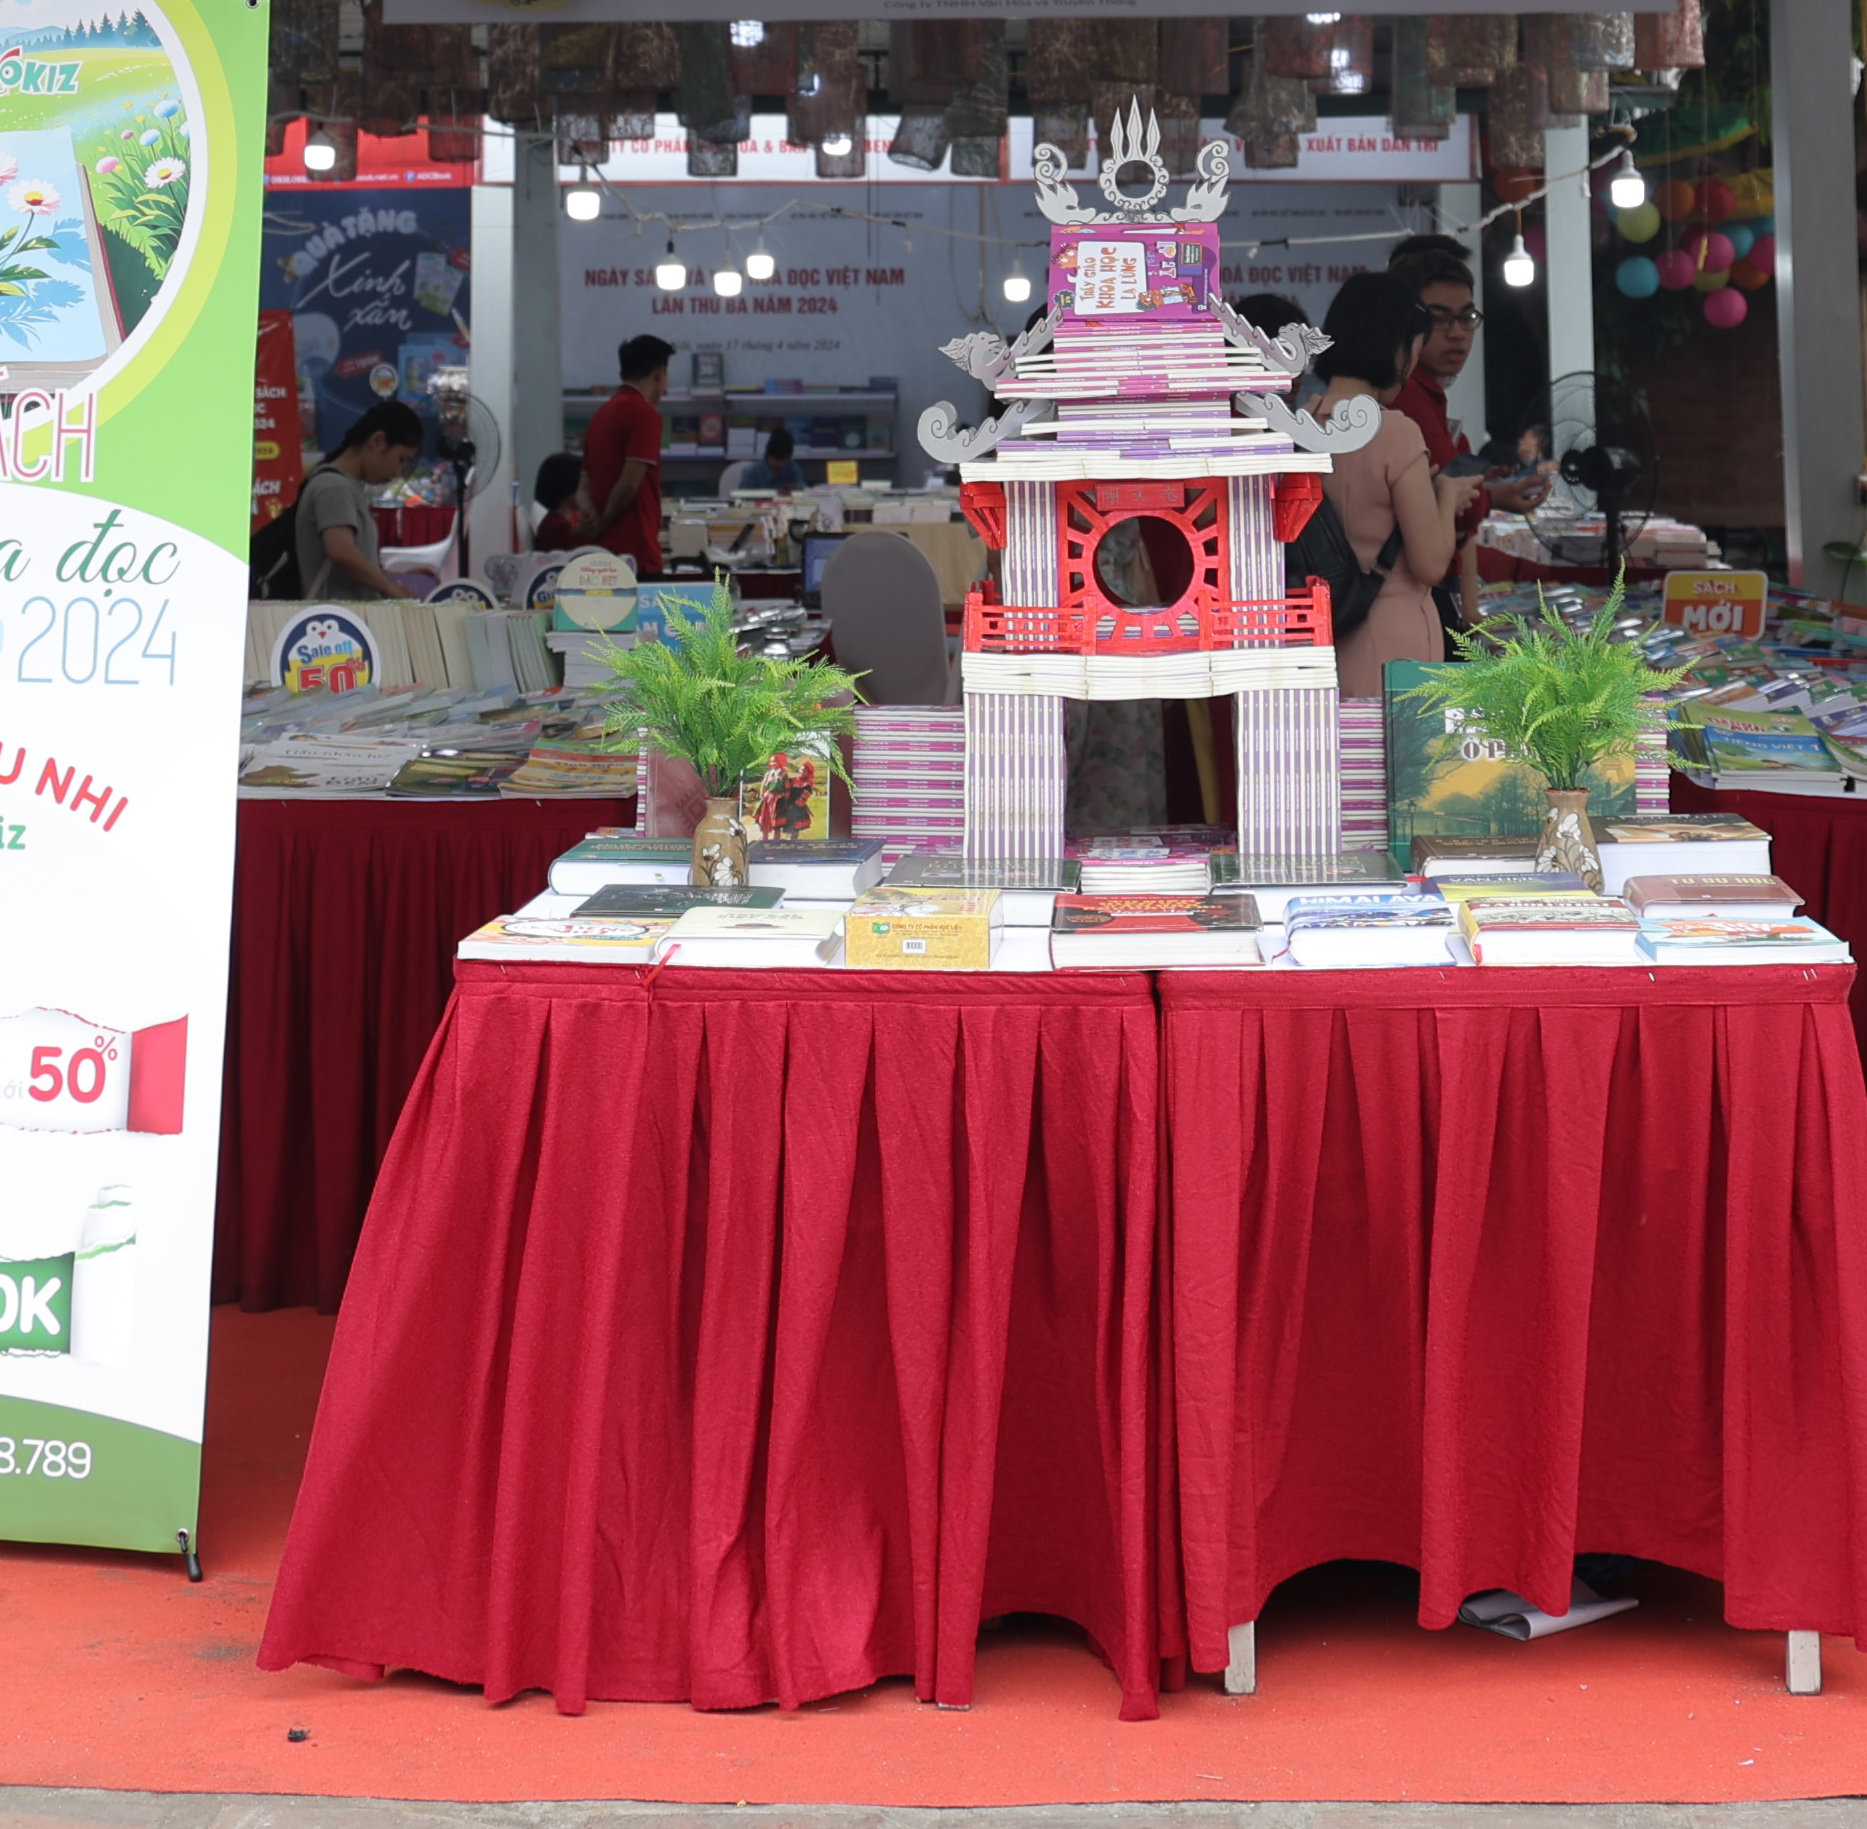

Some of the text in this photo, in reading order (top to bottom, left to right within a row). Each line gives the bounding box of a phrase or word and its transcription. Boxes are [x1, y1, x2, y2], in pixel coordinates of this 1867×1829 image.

[825, 267, 862, 289] VIỆT
[866, 268, 905, 286] NAM
[1095, 278, 1117, 309] KHOA
[797, 297, 838, 315] 2024
[56, 508, 180, 597] đọc
[1693, 577, 1735, 595] SÁCH
[1682, 599, 1744, 633] MỚI
[18, 596, 177, 686] 2024
[297, 642, 332, 665] Sale
[35, 759, 129, 832] NHI
